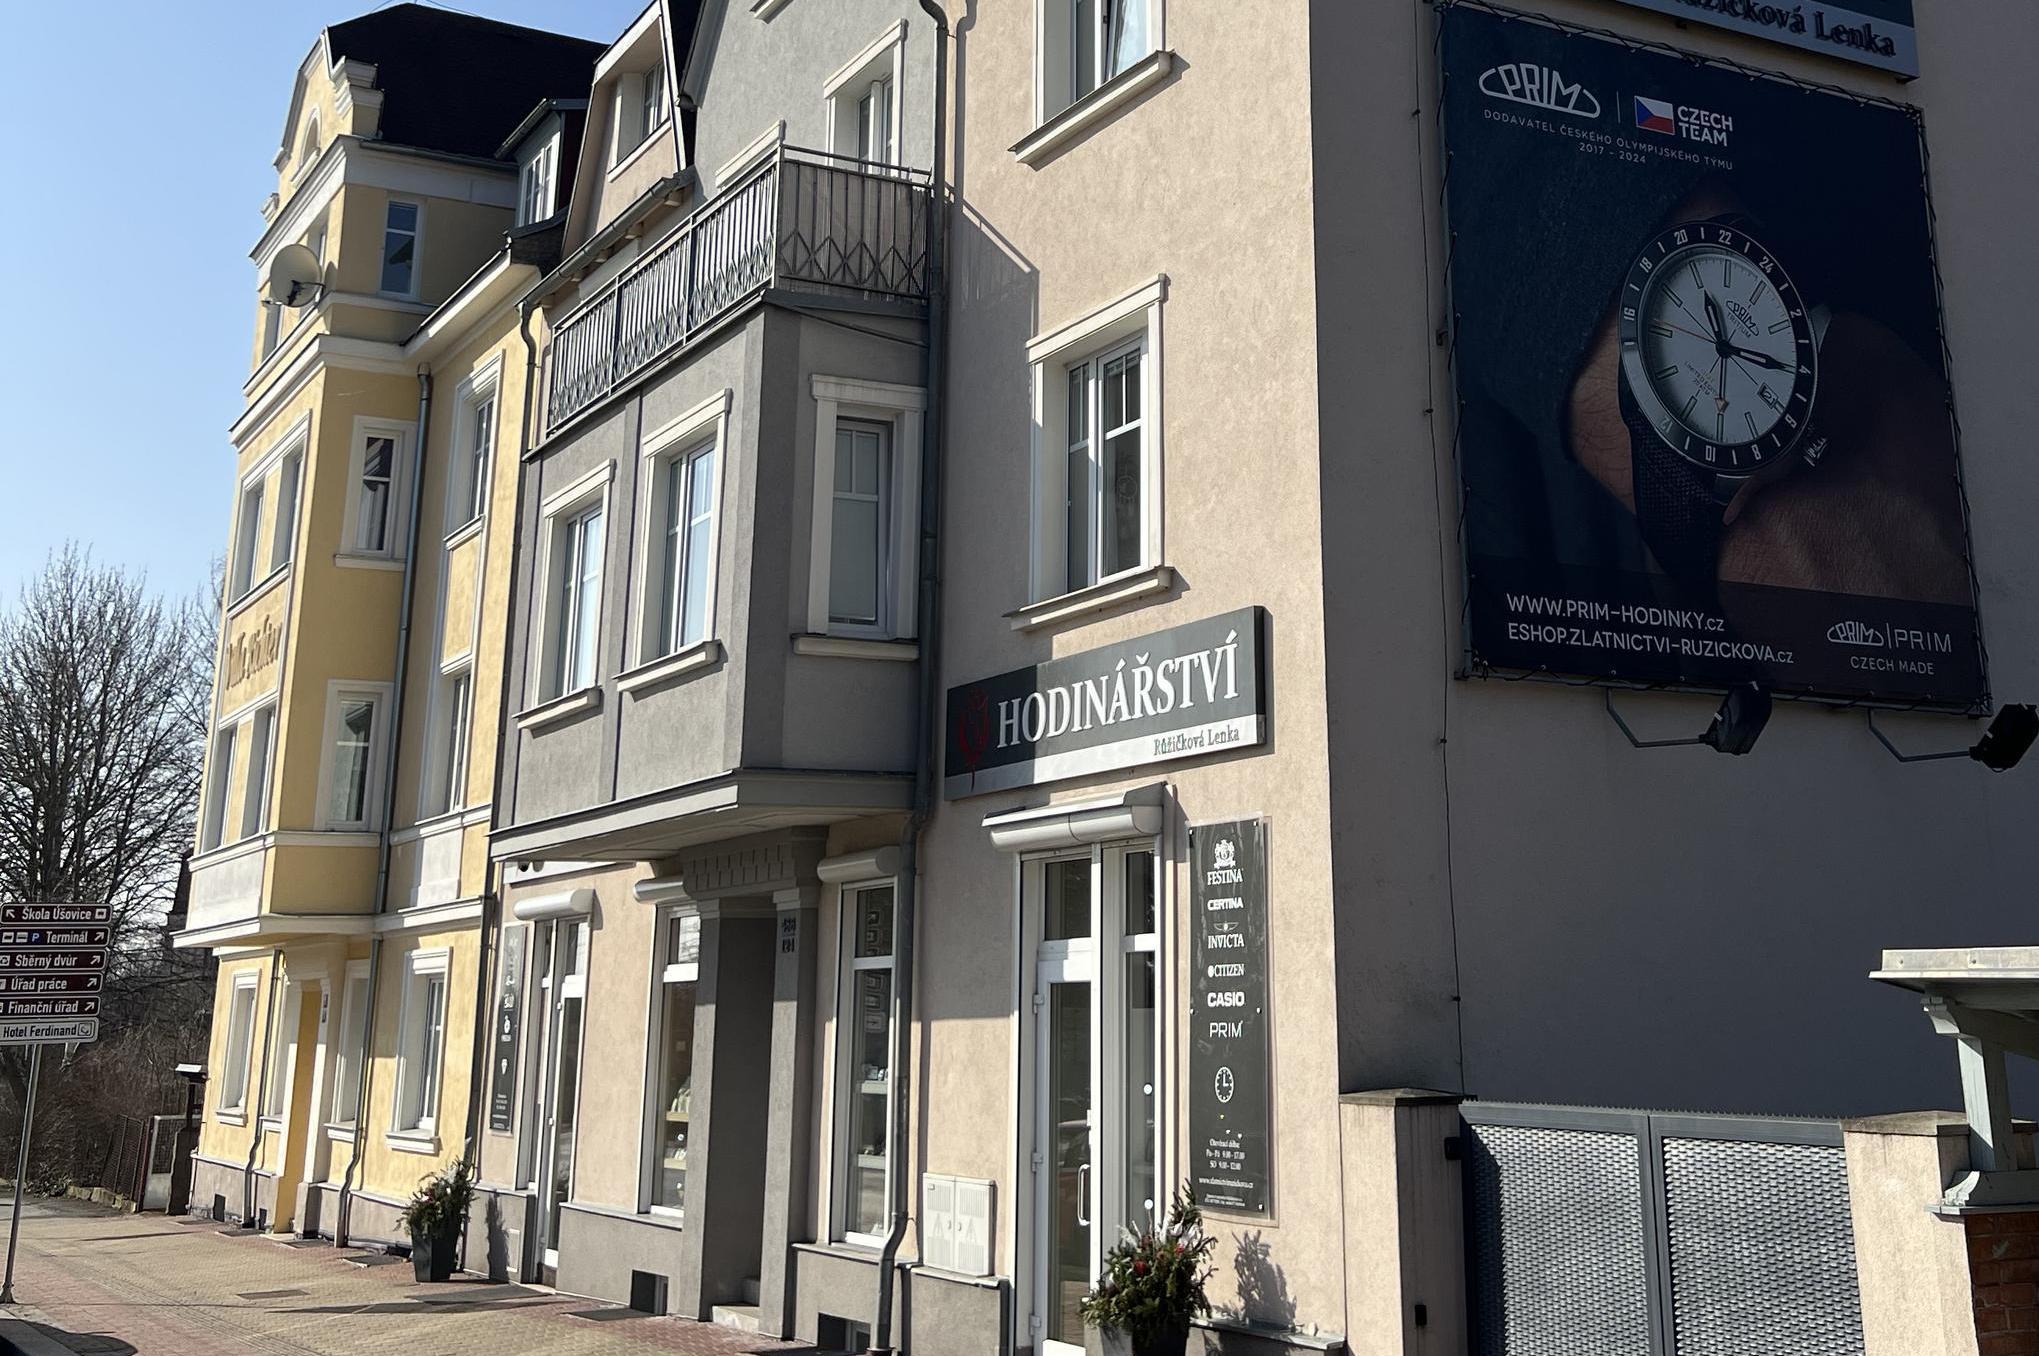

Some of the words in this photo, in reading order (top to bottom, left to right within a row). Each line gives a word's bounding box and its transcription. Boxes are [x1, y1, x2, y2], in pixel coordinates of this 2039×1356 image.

[1813, 10, 1896, 57] Lenka
[1494, 62, 1586, 115] PRIM
[1677, 105, 1733, 132] CZECH
[1483, 109, 1555, 133] DODAVATEL
[1559, 123, 1612, 145] ČESKÉHO
[1616, 137, 1700, 163] OLYMPIJSKÉHO
[1678, 121, 1728, 147] TEAM
[1579, 142, 1604, 155] 2017
[1619, 150, 1646, 164] 2024
[1673, 229, 1688, 246] 20
[1718, 229, 1733, 245] 22
[1639, 256, 1653, 273] 18
[1759, 255, 1774, 274] 24
[1623, 306, 1636, 321] 16
[1705, 445, 1716, 463] 10
[1832, 620, 1878, 644] PRIM
[1894, 629, 1952, 653] PRIM
[1850, 656, 1894, 671] CZECH
[1899, 660, 1935, 675] MADE
[996, 628, 1240, 749] HODINÁŘSTVÍ
[1153, 729, 1205, 756] Růžičková
[1207, 723, 1240, 746] Lenka
[1207, 868, 1243, 885] FESTINA
[22, 906, 50, 920] Škola
[53, 905, 92, 920] Úšovice
[1207, 897, 1244, 911] CERTINA
[46, 931, 88, 943] Terminál
[1207, 933, 1245, 949] INVICTA
[15, 954, 51, 969] Sběrný
[1214, 963, 1245, 977] CITIZEN
[11, 976, 36, 991] Úřad
[38, 977, 67, 993] práce
[8, 1001, 52, 1014] Finanční
[54, 1001, 79, 1013] úřad
[1207, 991, 1245, 1007] CASIO
[3, 1026, 27, 1038] Hotel
[30, 1024, 77, 1037] Ferdinand
[1210, 1020, 1243, 1038] PRIM
